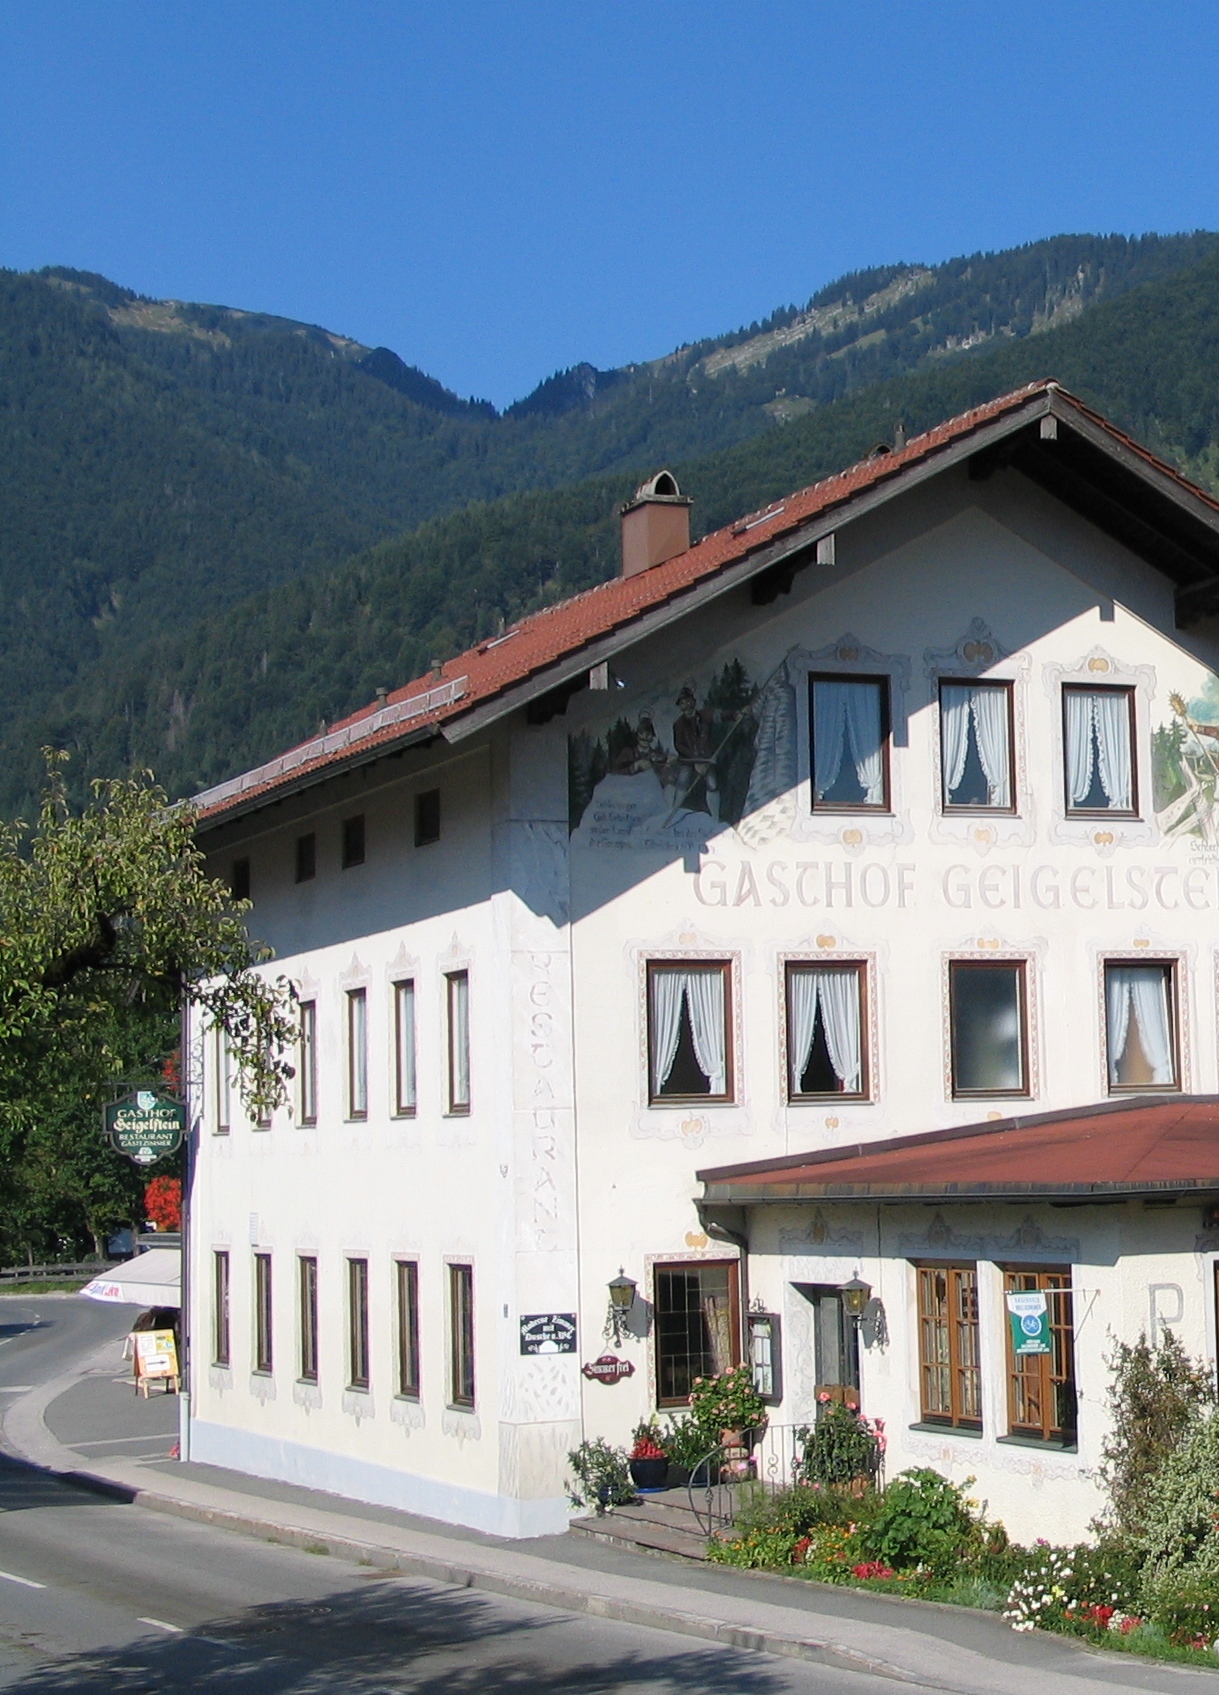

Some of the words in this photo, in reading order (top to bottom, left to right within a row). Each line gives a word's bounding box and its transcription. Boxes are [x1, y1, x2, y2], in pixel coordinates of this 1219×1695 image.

[692, 859, 917, 908] GASTHOF
[117, 1108, 177, 1118] GASTHOF
[118, 1133, 174, 1141] RESTAURANT
